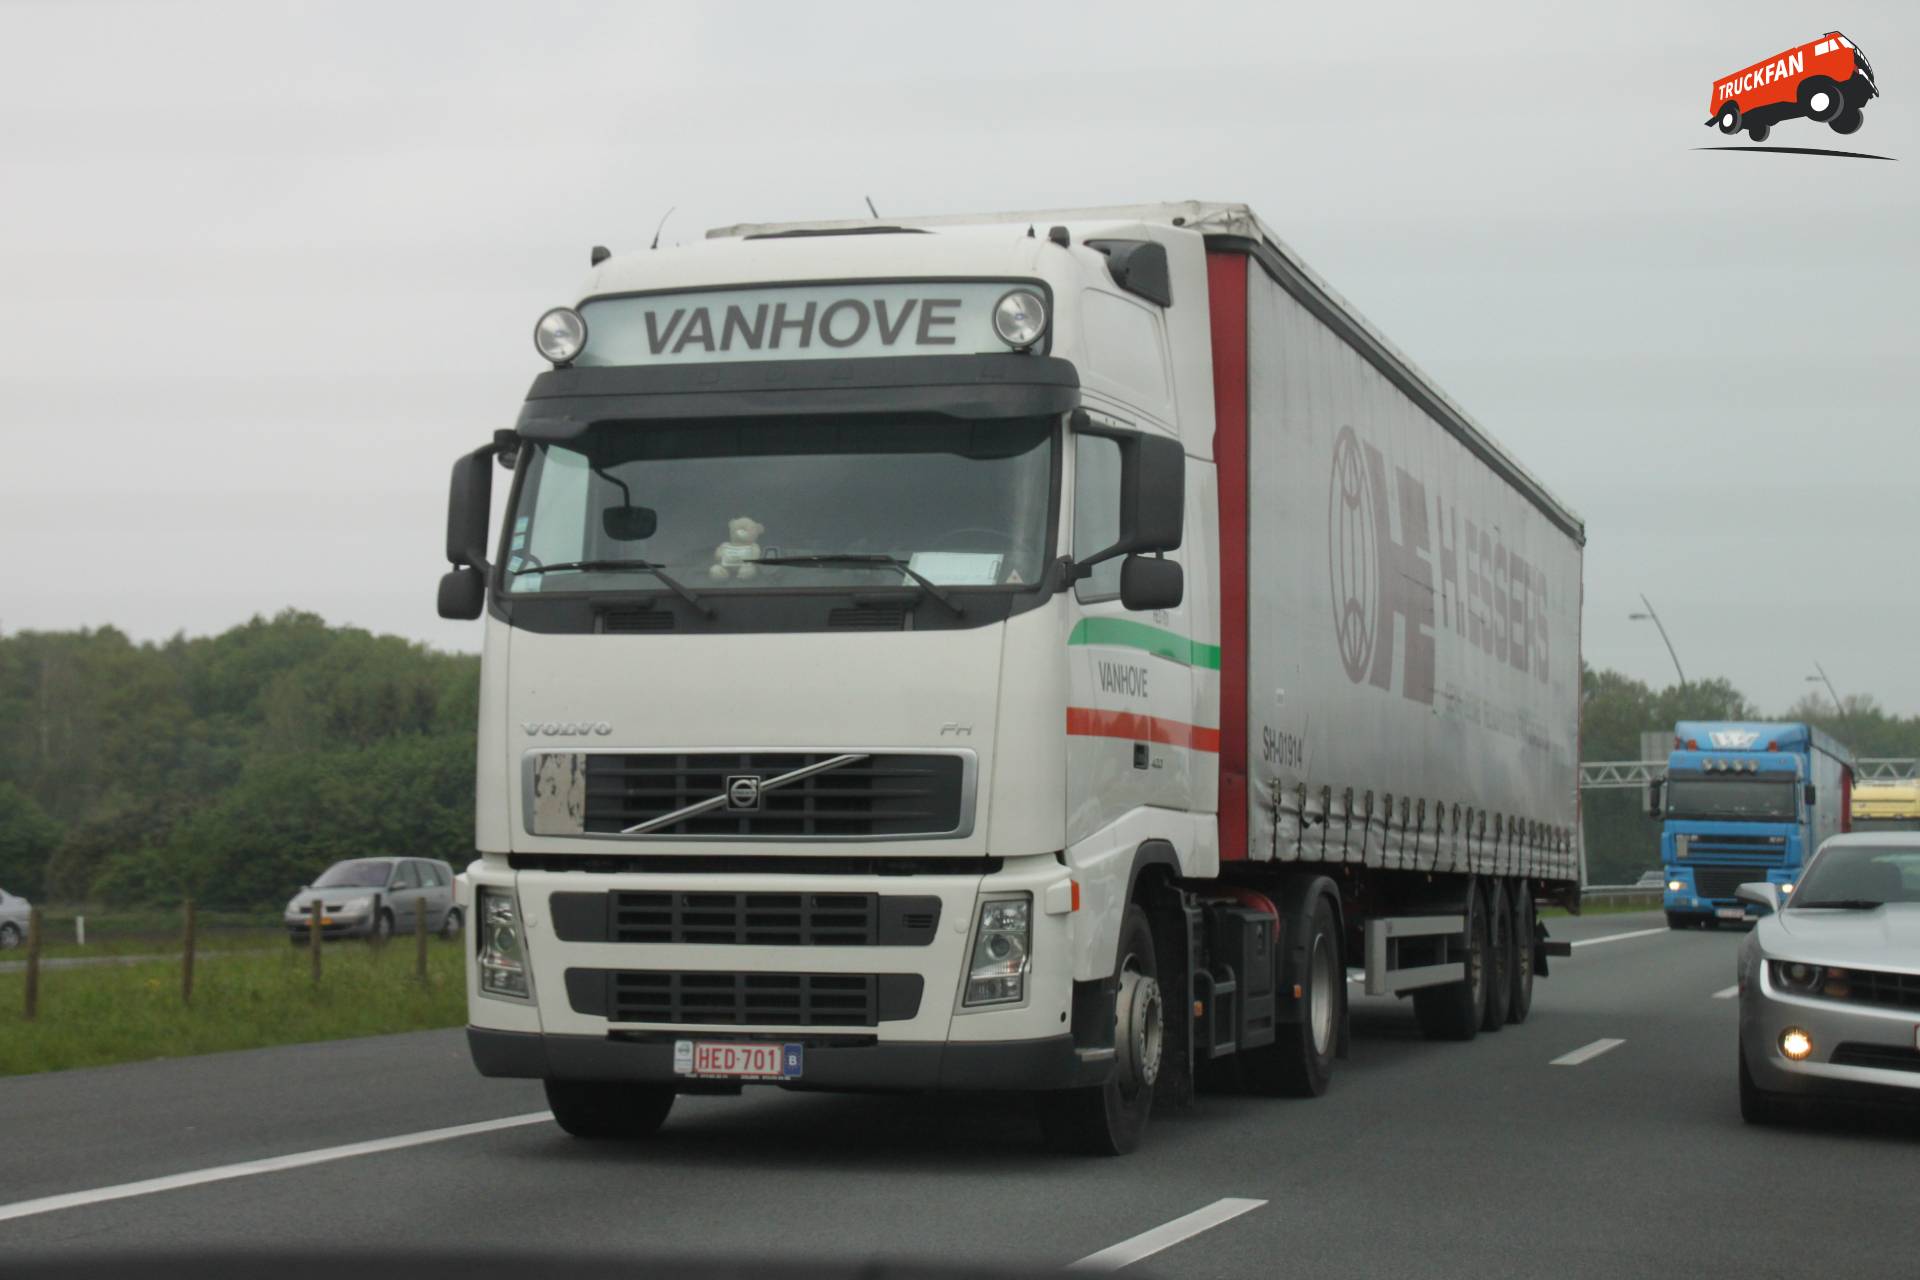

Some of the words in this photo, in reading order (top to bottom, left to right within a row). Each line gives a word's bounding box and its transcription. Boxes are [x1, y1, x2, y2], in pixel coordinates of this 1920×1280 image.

[643, 297, 962, 355] VANHOVE
[1098, 661, 1149, 698] VANHOVE
[520, 719, 613, 737] VOLVO
[939, 721, 974, 737] FH
[1262, 724, 1303, 770] SH-01914
[788, 1054, 797, 1066] B
